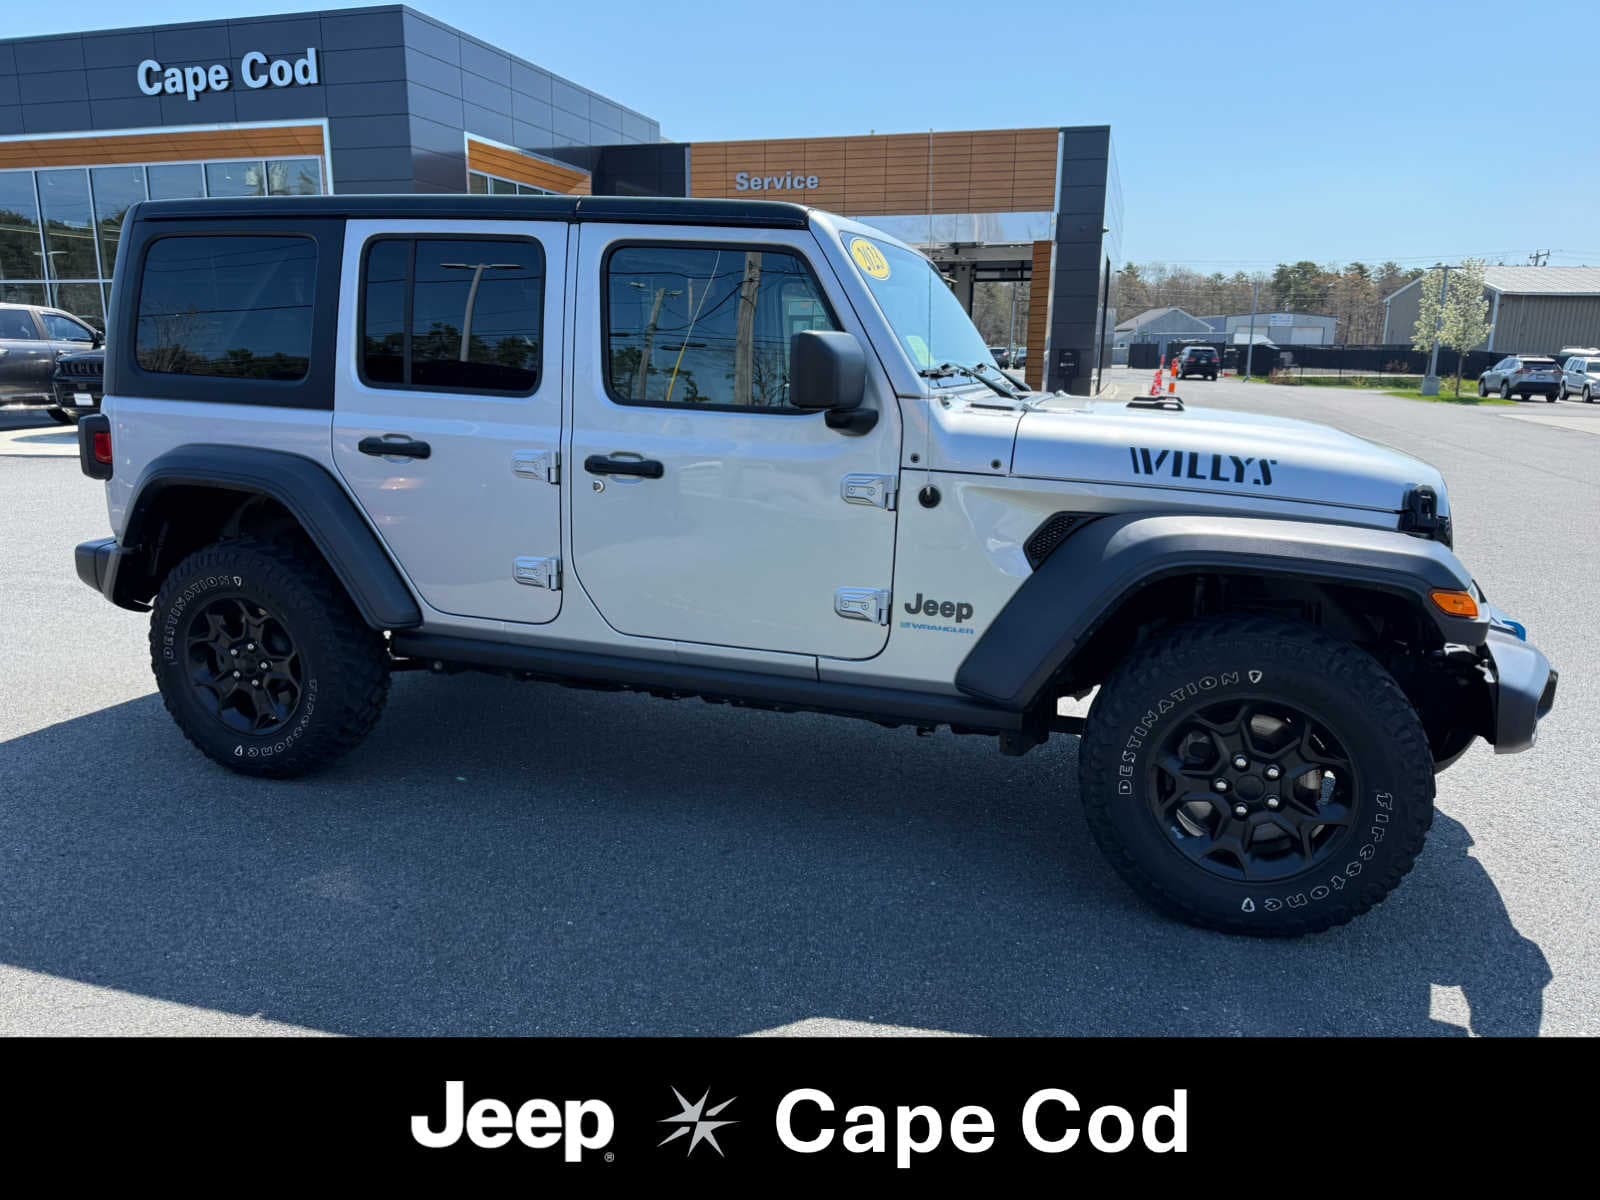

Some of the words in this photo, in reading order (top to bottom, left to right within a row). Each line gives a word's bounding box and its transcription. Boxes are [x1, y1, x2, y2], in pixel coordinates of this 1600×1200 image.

[137, 59, 231, 101] Cape
[241, 48, 319, 89] Cod
[735, 171, 819, 191] Service
[1130, 447, 1278, 486] WILLYS
[163, 575, 230, 660] DESTINATION
[904, 592, 974, 623] Jeep
[1119, 671, 1239, 795] DESTINATION
[1264, 792, 1393, 911] Firestone
